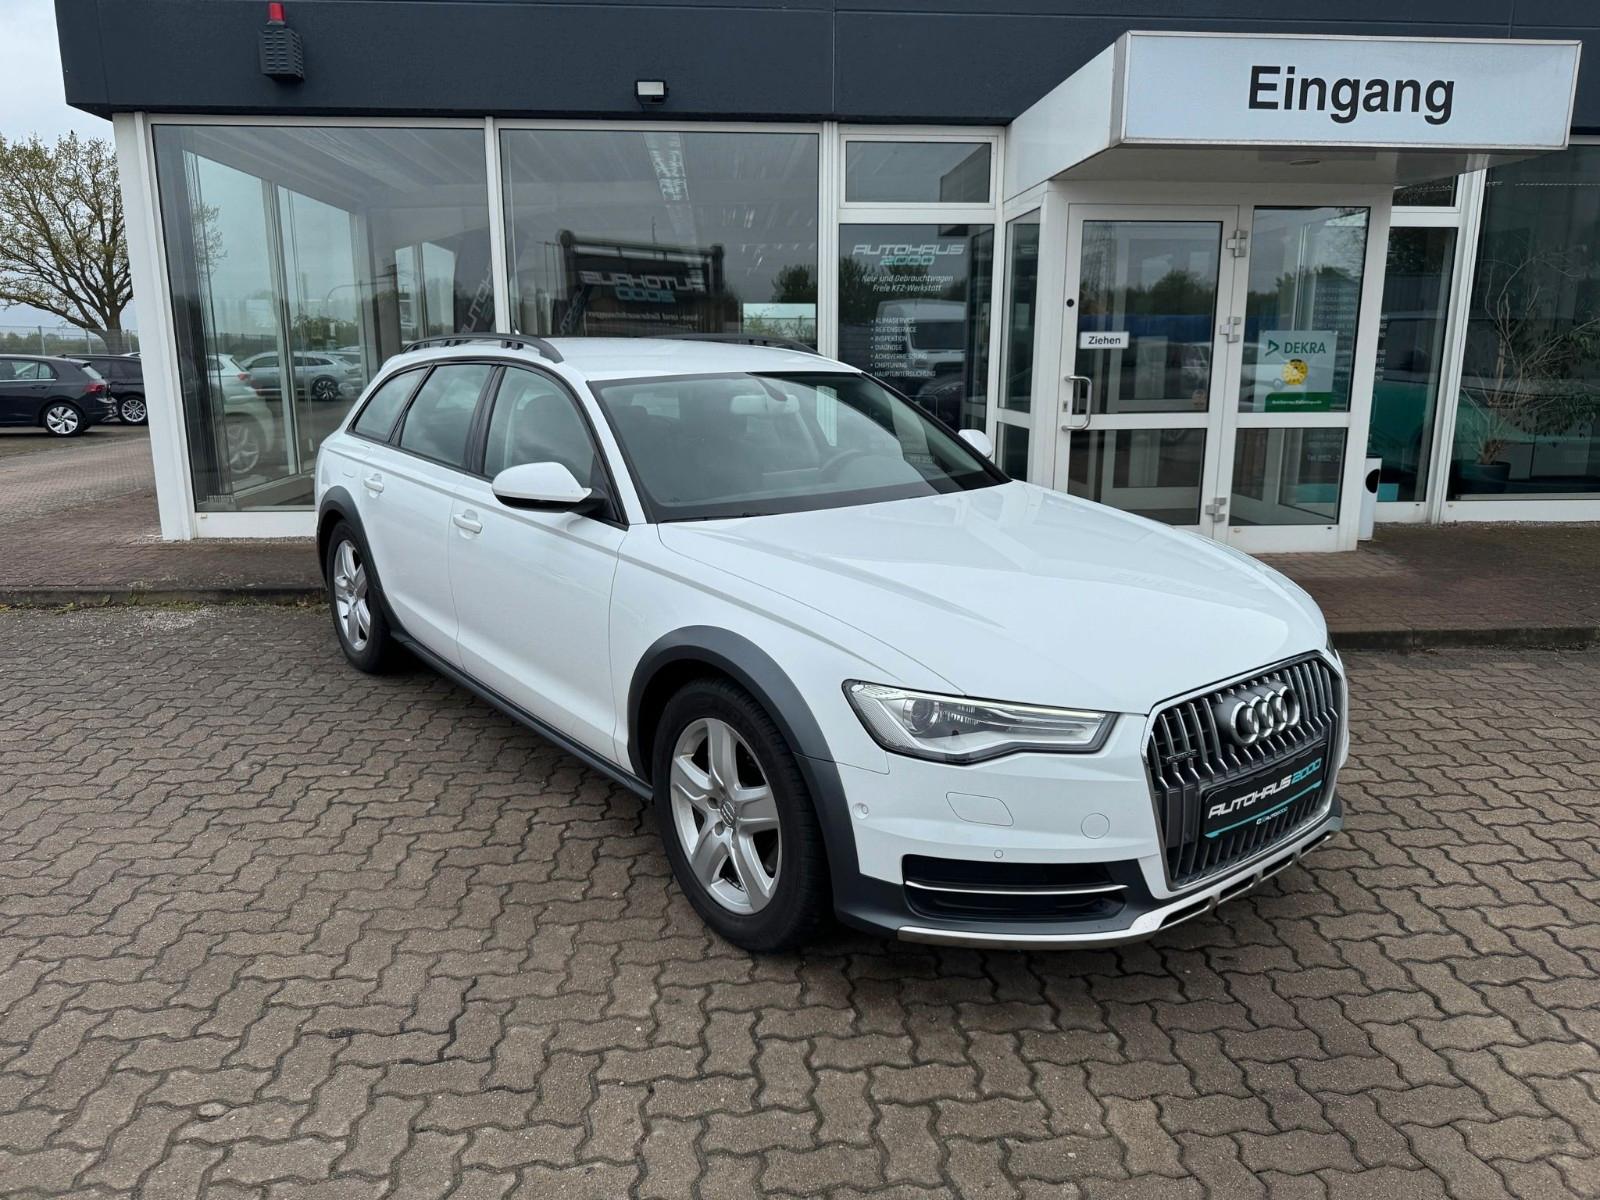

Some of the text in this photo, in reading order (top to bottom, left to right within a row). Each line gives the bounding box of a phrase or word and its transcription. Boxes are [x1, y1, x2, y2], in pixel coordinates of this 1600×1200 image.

[1249, 65, 1455, 125] Eingang
[852, 244, 965, 256] AUTOHAUS
[880, 255, 935, 266] 2000
[1088, 336, 1121, 345] Ziehen
[1284, 341, 1327, 354] DEKRA
